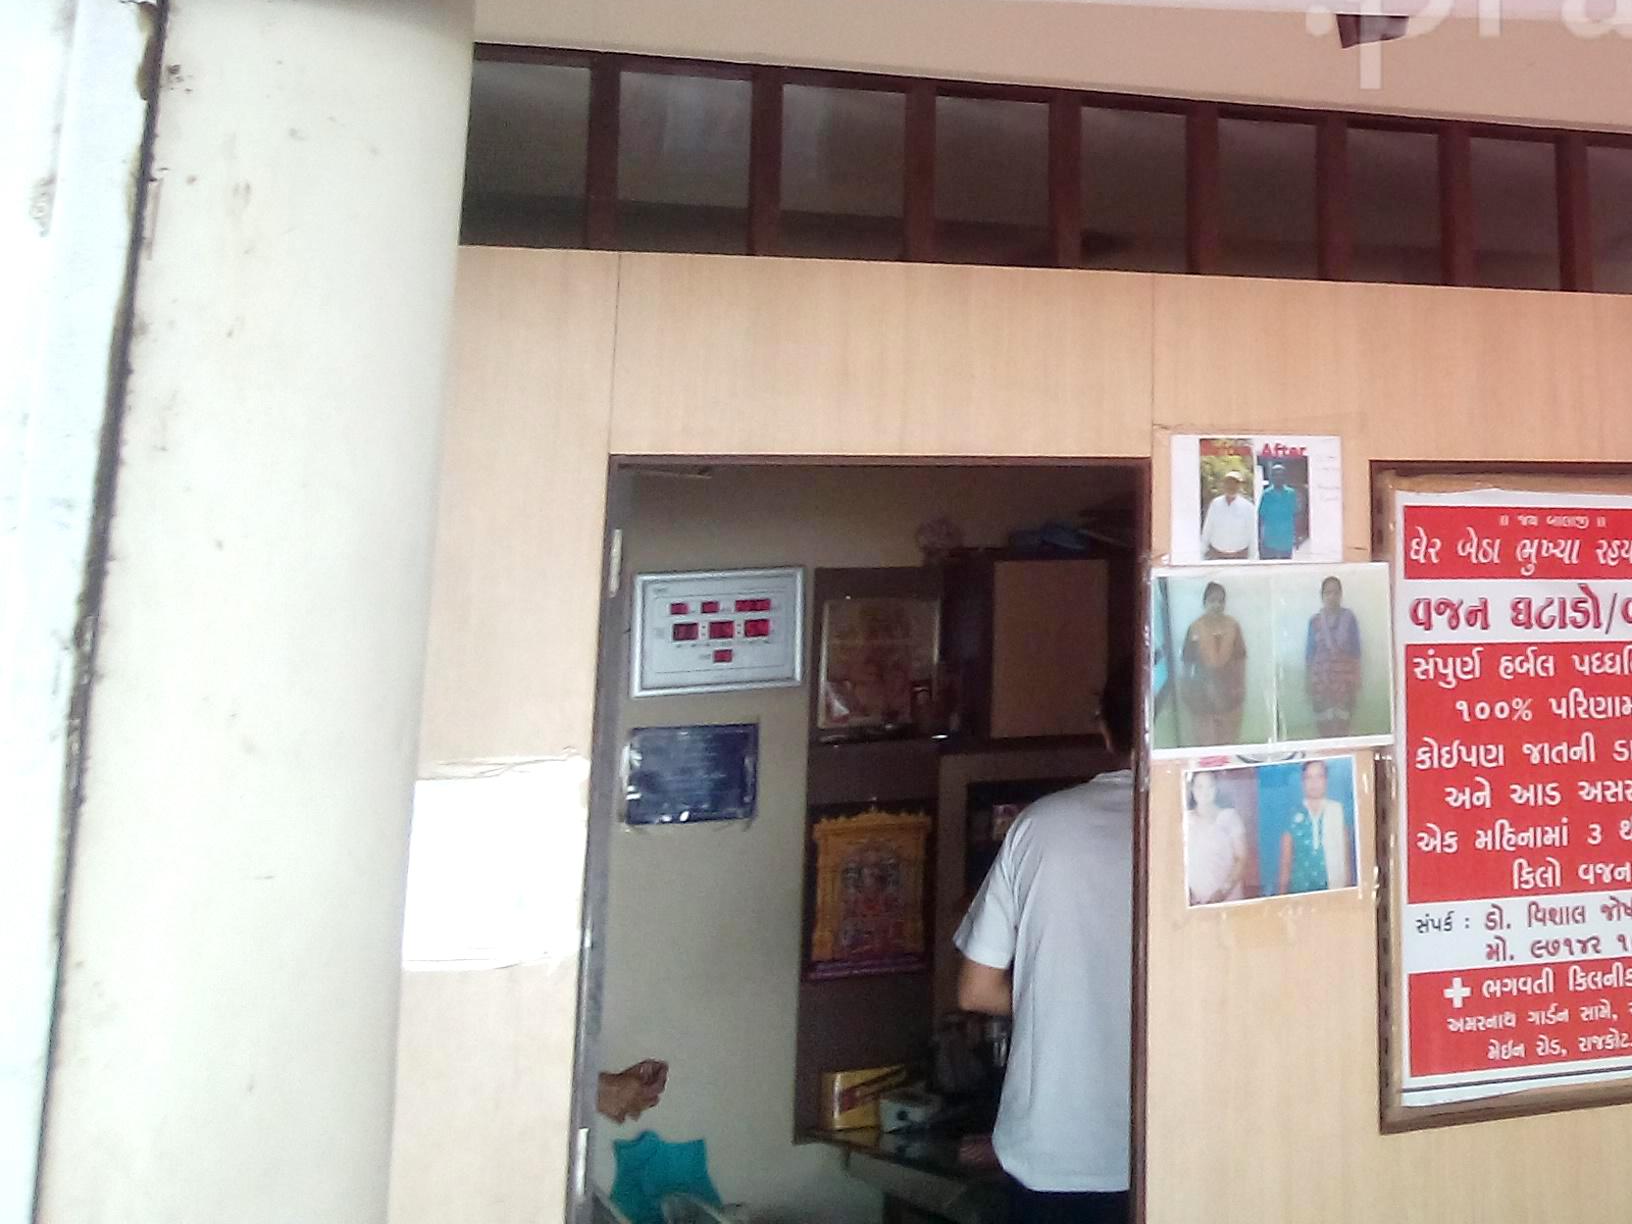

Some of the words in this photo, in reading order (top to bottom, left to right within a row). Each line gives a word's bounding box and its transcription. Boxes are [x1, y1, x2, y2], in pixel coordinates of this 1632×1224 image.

[1409, 526, 1442, 564] ઘેર
[1457, 526, 1501, 564] બેઠા
[1515, 538, 1580, 576] ભુખ્યા
[1409, 597, 1491, 630] વજન
[1412, 646, 1484, 689] સંપુર્ણ
[1499, 646, 1555, 680] હર્બલ
[1455, 697, 1534, 722] ૧૦૦%
[1415, 736, 1505, 769] કોઈપણ
[1522, 731, 1596, 764] જાતની
[1444, 776, 1492, 810] અને
[1509, 783, 1562, 807] આડ
[1416, 823, 1459, 854] એક
[1474, 817, 1569, 852] મહિનામાં
[1511, 857, 1562, 890] કિલો
[1577, 861, 1632, 885] વજન
[1484, 903, 1511, 931] ડો.
[1528, 899, 1586, 928] વિશાલ
[1485, 935, 1515, 962] મો.
[1481, 966, 1555, 999] ભગવતી
[1447, 1010, 1517, 1033] અમરનાથ
[1528, 1004, 1570, 1027] ગાર્ડન
